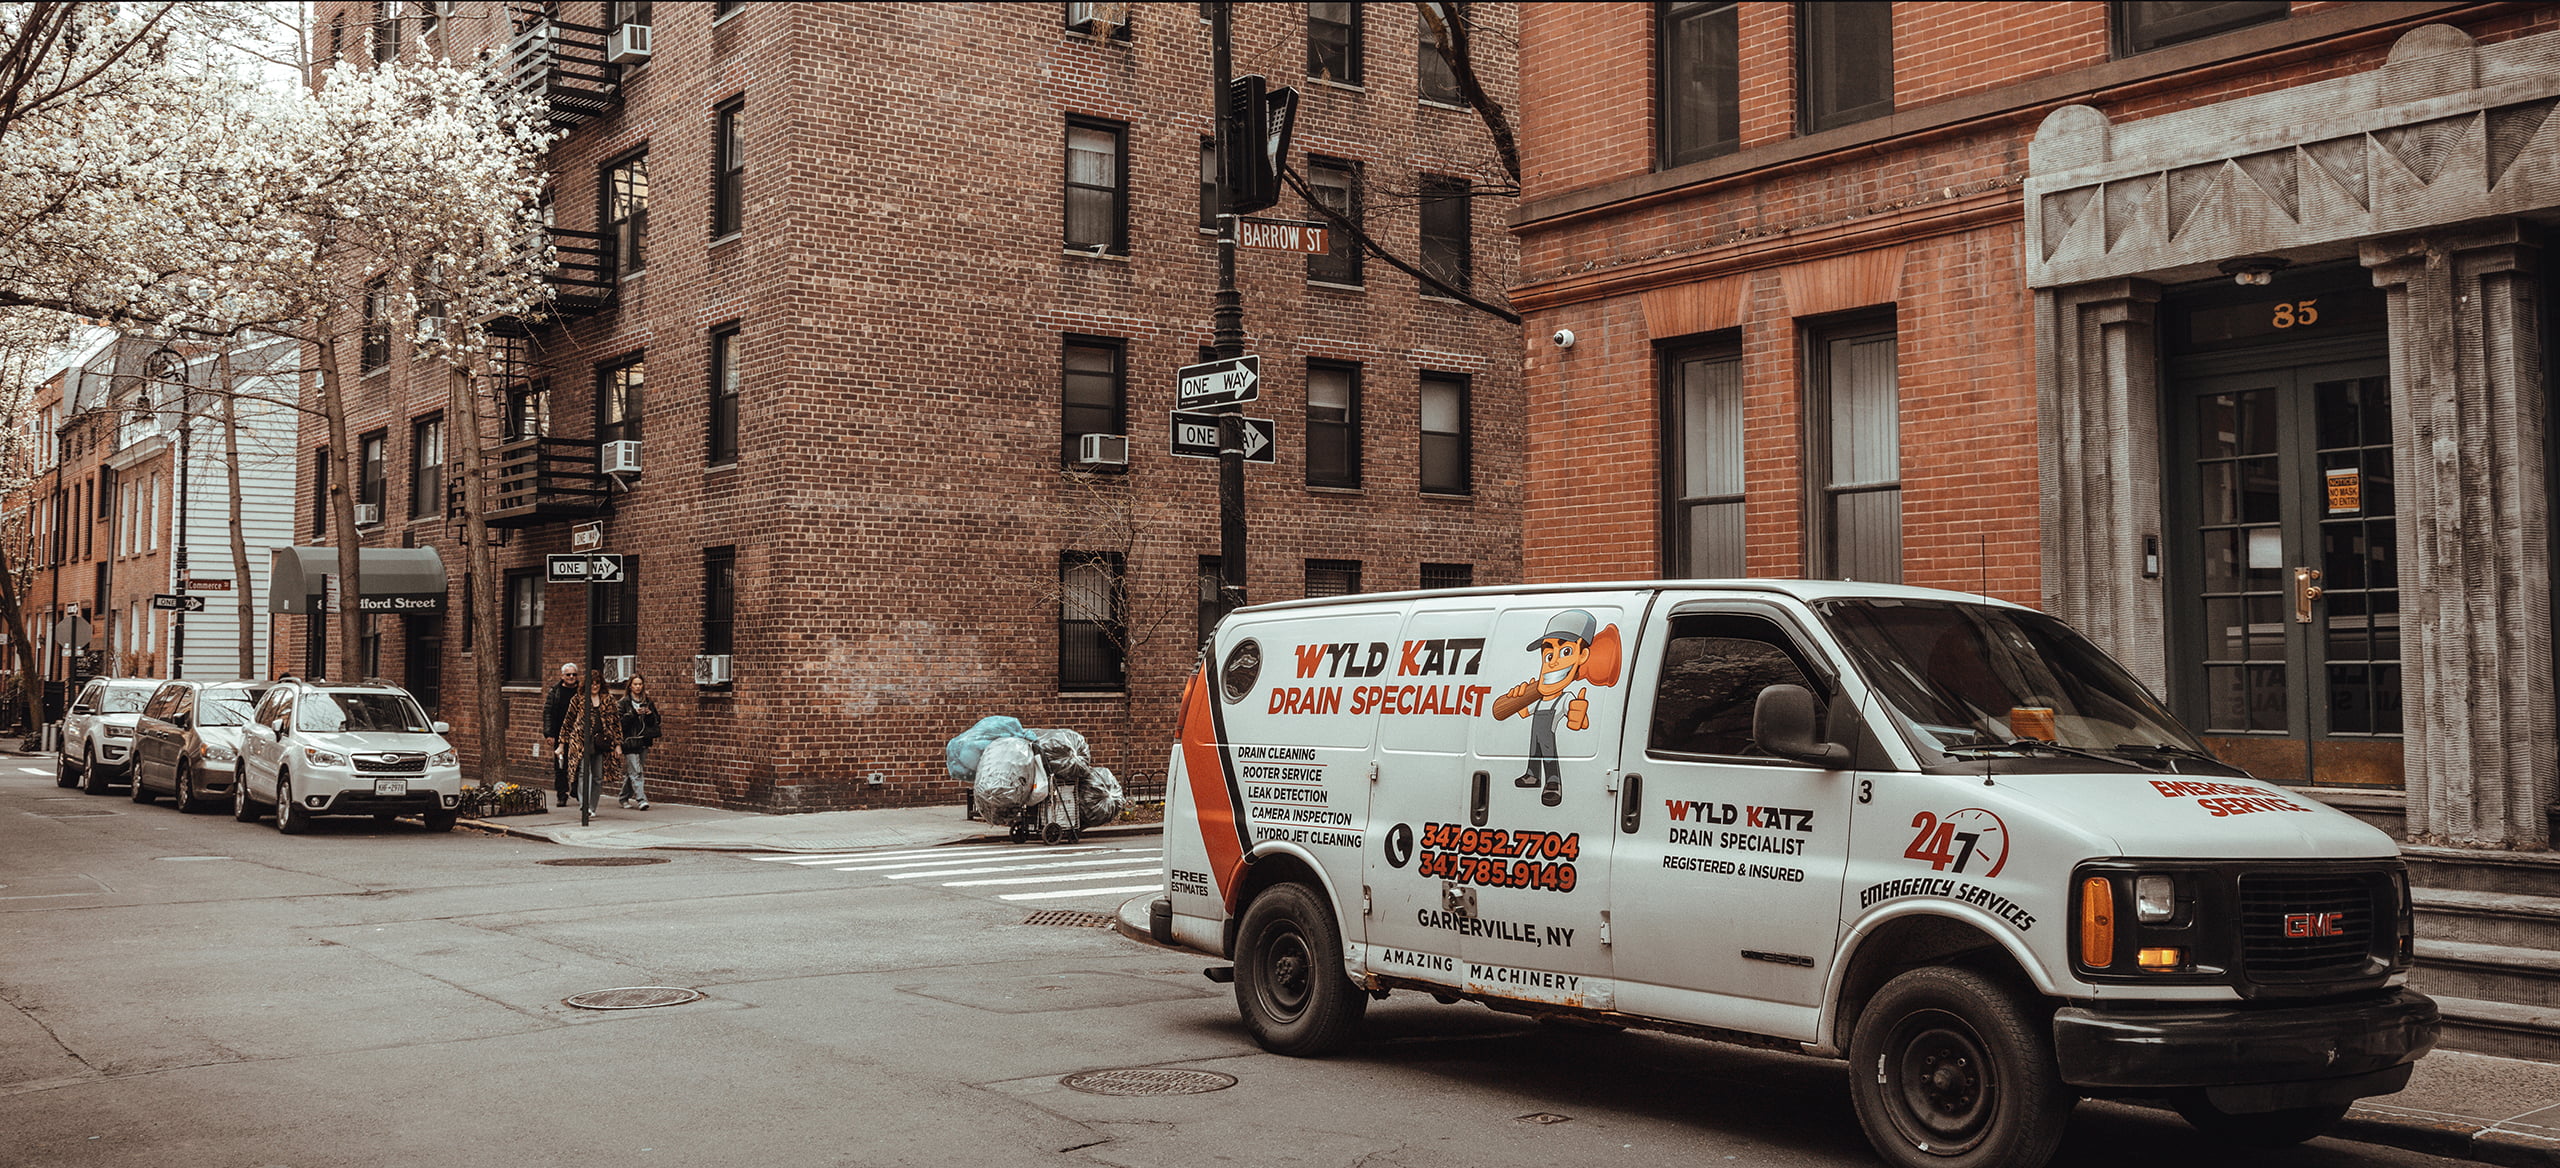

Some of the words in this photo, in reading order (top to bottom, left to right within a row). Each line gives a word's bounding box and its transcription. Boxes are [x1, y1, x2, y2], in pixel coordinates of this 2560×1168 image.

[1243, 222, 1300, 250] BARROW
[1306, 228, 1322, 252] ST
[2272, 298, 2319, 328] 85
[1184, 377, 1210, 396] ONE
[1223, 370, 1249, 390] WAY
[1186, 426, 1216, 445] ONE
[1243, 431, 1259, 449] AY
[2329, 487, 2340, 497] NO
[2340, 486, 2358, 496] MASK
[2329, 497, 2338, 506] NO
[2339, 496, 2358, 505] ENTRY
[559, 563, 580, 573] ONE
[189, 580, 223, 590] Commerce
[160, 598, 176, 606] ONE
[394, 596, 437, 610] Street
[1295, 641, 1390, 679] WYLD
[1397, 637, 1486, 677] KATZ
[1268, 686, 1343, 715] DRAIN
[1349, 684, 1492, 718] SPECIALIST
[1238, 746, 1267, 759] DRAIN
[1267, 747, 1316, 761] CLEANING
[1243, 766, 1280, 779] ROOTER
[1281, 768, 1323, 782] SERVICE
[1248, 786, 1273, 800] LEAK
[1273, 788, 1328, 803] DETECTION
[1858, 779, 1873, 804] 3
[1252, 806, 1290, 821] CAMERA
[1292, 810, 1353, 826] INSPECTION
[1665, 799, 1738, 825] WYLD
[1746, 805, 1814, 832] KATZ
[1257, 827, 1290, 841] HYDRO
[1291, 830, 1309, 844] JET
[1310, 833, 1363, 848] CLEANING
[1669, 828, 1713, 847] DRAIN
[1720, 832, 1805, 856] SPECIALIST
[1171, 869, 1208, 884] FREE
[1663, 855, 1736, 875] REGISTERED
[1738, 863, 1746, 876] &
[1749, 864, 1805, 883] INSURED
[1171, 881, 1208, 896] ESTIMATES
[1860, 877, 1955, 910] EMERGENCY
[1955, 883, 2037, 932] SERVICES
[1418, 908, 1542, 948] GARNERVILLE,
[1546, 926, 1575, 948] NY
[2284, 912, 2343, 938] GMC
[1383, 948, 1453, 972] AMAZING
[1470, 964, 1579, 991] MACHINERY
